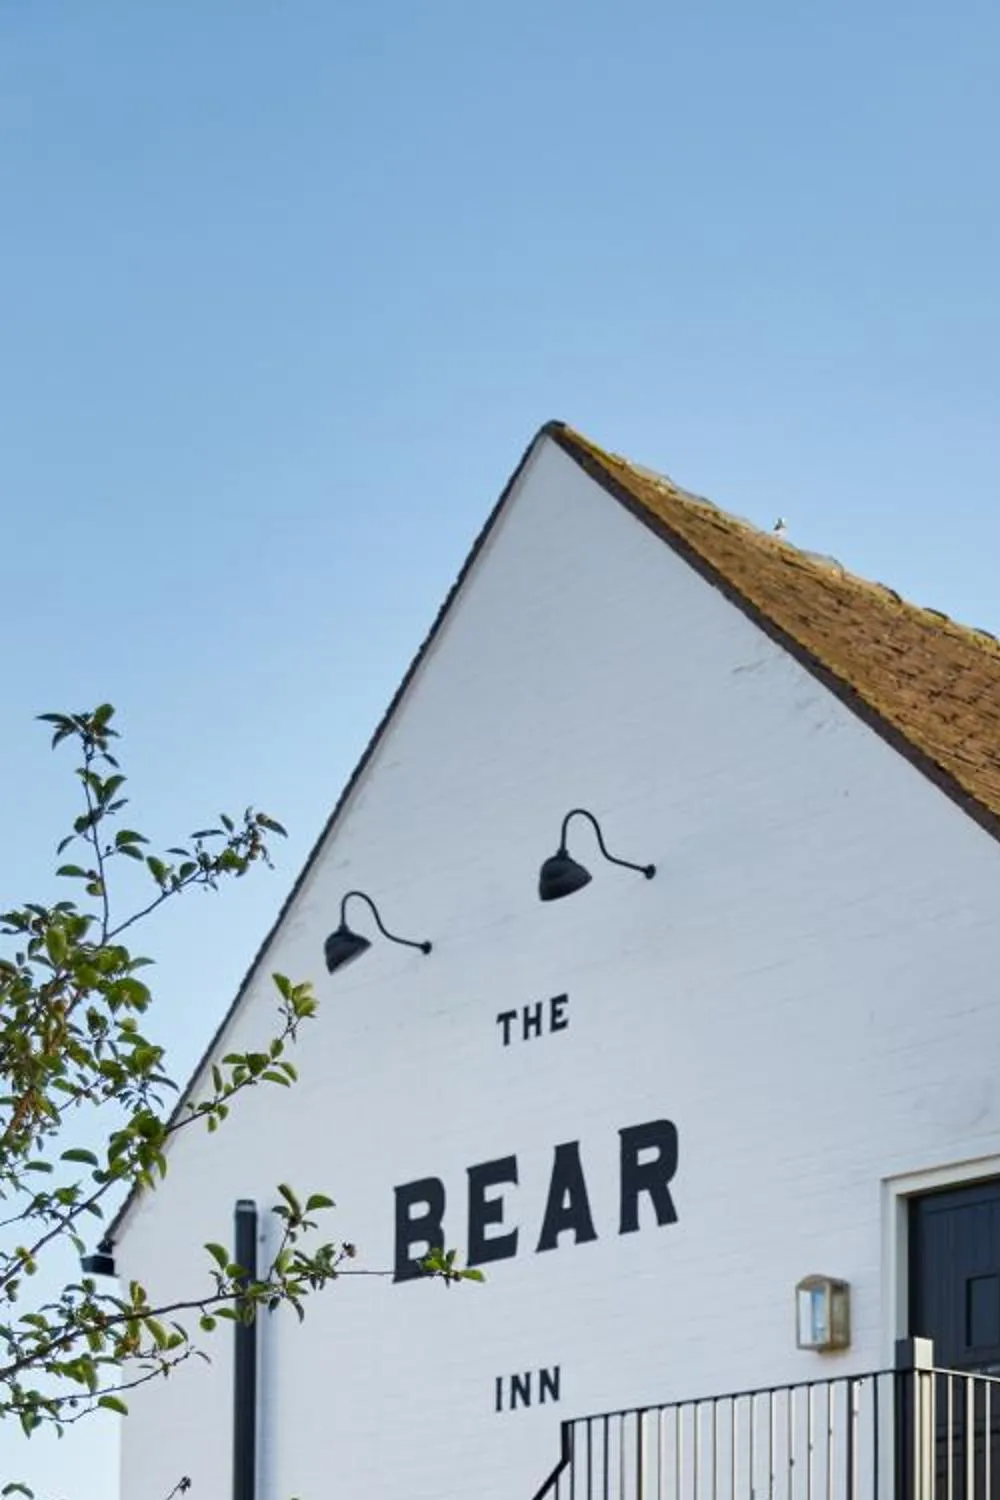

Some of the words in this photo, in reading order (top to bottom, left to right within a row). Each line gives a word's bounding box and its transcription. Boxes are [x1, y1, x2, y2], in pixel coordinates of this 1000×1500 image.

[496, 993, 569, 1046] THE
[392, 1118, 679, 1284] BEAR
[494, 1365, 561, 1412] INN
